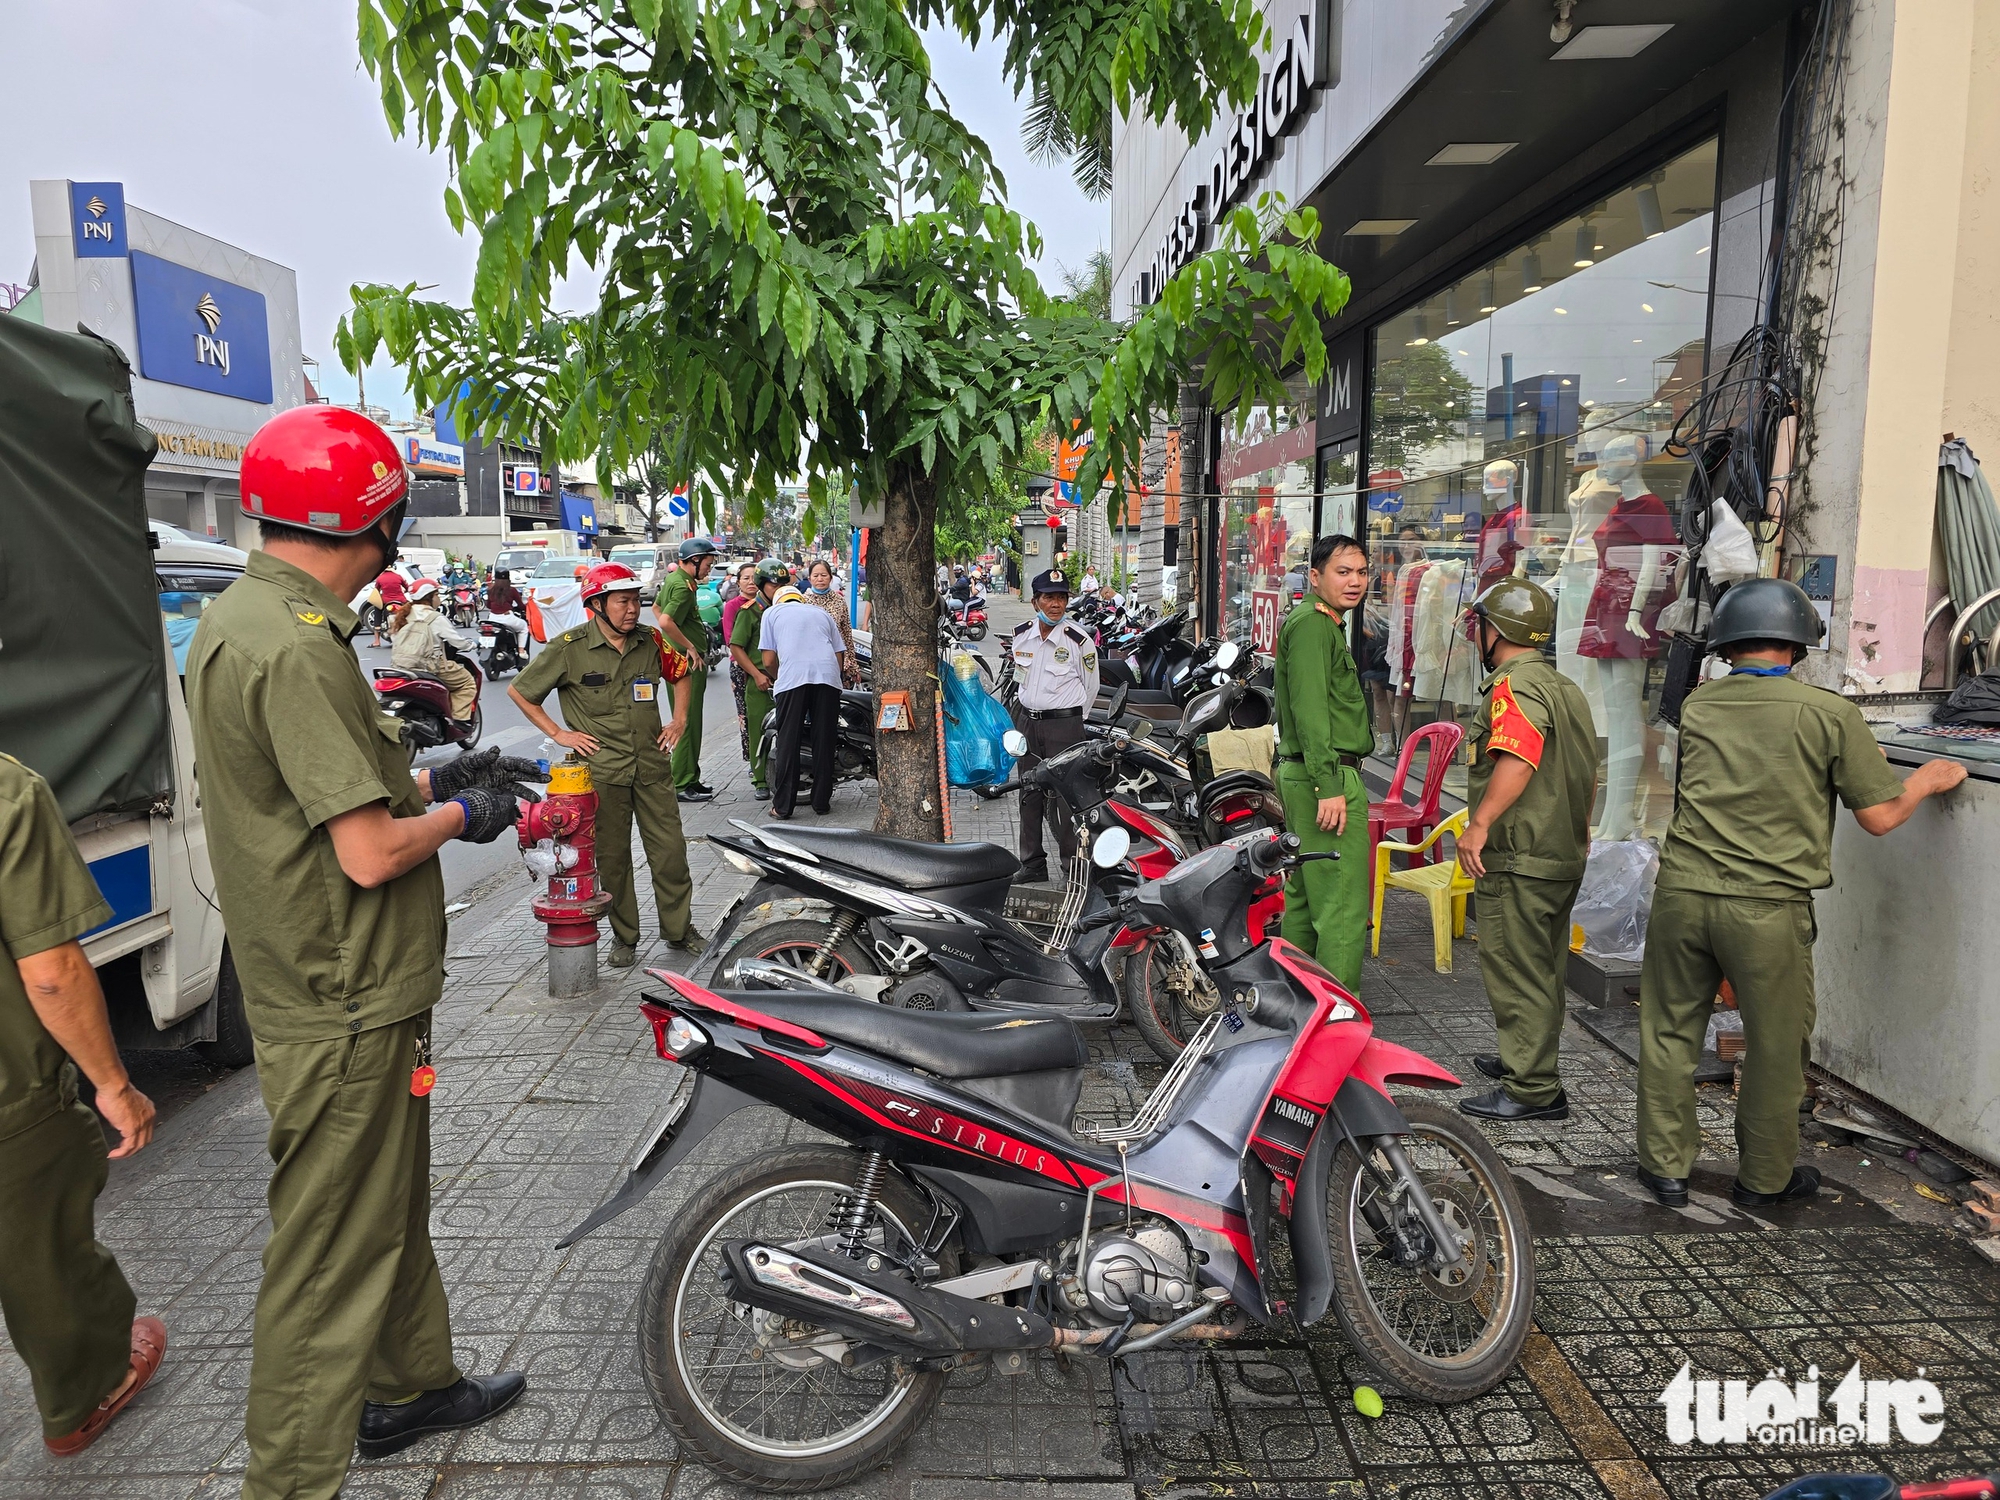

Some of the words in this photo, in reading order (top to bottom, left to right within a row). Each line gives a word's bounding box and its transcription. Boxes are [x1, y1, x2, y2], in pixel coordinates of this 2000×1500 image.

[1150, 185, 1200, 305] DRESS
[1209, 0, 1317, 225] DESIGN
[82, 221, 112, 243] PNJ
[193, 332, 231, 377] PNJ
[1324, 358, 1351, 418] JM
[156, 432, 178, 454] NG
[214, 441, 238, 461] KIM
[1064, 456, 1080, 465] KHU
[1234, 822, 1251, 830] HONDA
[941, 944, 975, 962] SUZUKI
[1274, 1098, 1315, 1128] YAMAHA
[885, 1101, 920, 1118] Fi
[931, 1118, 1046, 1172] SIRIUS
[1265, 1162, 1294, 1177] INJECTION
